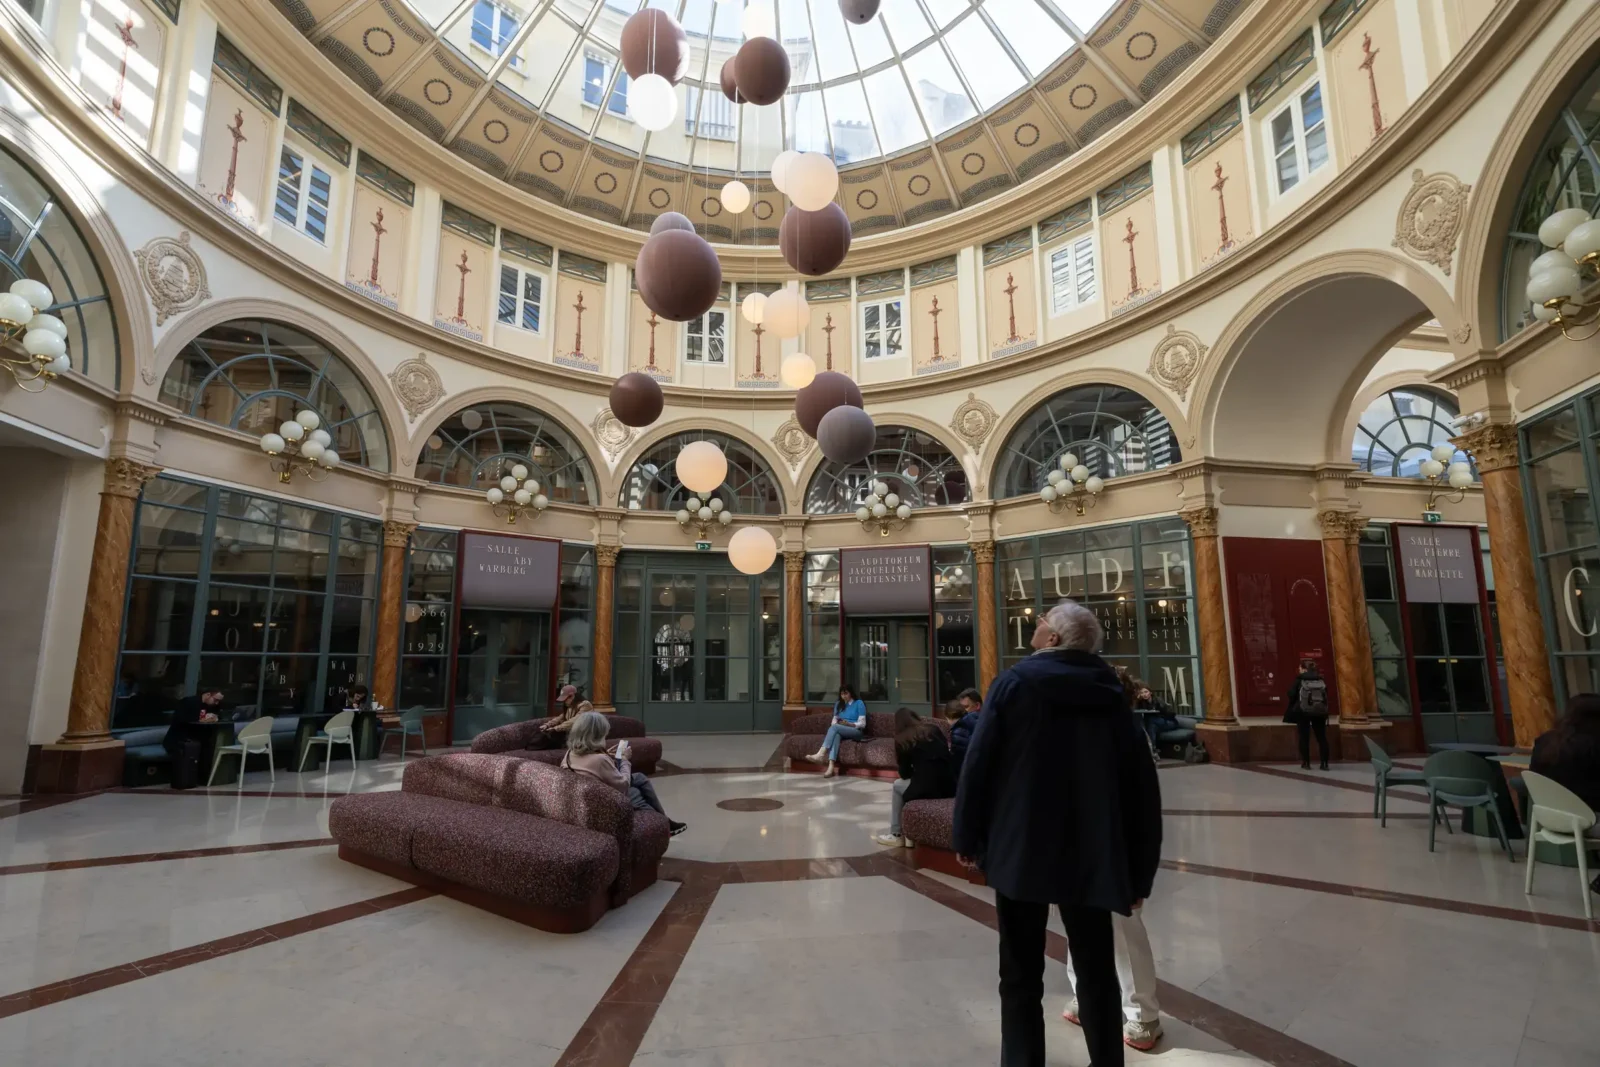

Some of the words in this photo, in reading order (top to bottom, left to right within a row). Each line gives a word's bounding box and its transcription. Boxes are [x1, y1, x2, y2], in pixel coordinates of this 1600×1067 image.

[1410, 536, 1441, 547] SALLE
[487, 544, 520, 555] SALLE
[1424, 547, 1461, 558] PIERRE
[513, 556, 533, 566] ABY
[860, 555, 921, 566] AUDITORIUM
[1408, 557, 1432, 567] JEAN
[479, 563, 527, 575] WARBURG
[848, 565, 909, 575] JACQUELINE
[1415, 568, 1464, 579] MARIETTE
[848, 574, 921, 584] LICHTENSTEIN
[411, 607, 447, 618] 1866
[408, 642, 444, 653] 1929
[940, 645, 971, 654] 2019
